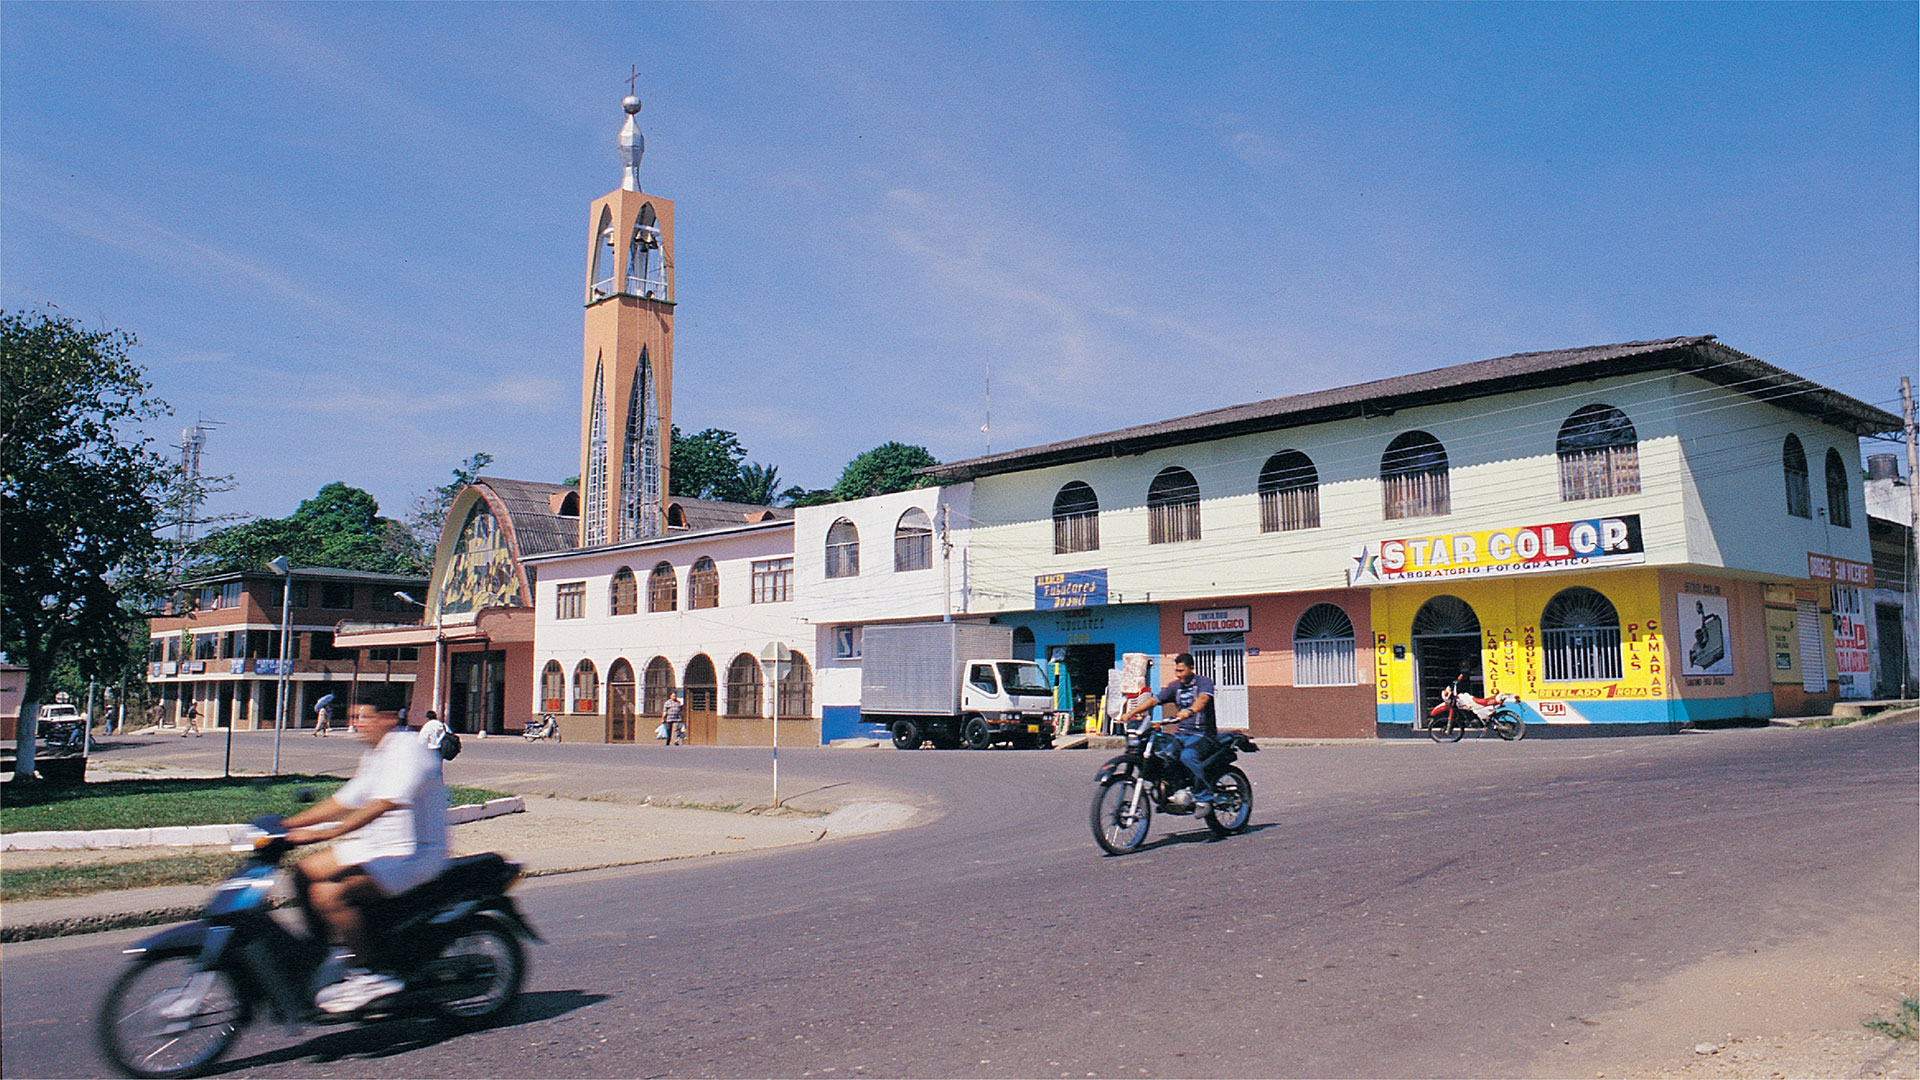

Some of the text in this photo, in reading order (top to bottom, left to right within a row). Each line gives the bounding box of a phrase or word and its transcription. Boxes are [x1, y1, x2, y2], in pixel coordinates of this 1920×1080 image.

[1382, 518, 1629, 570] STAR COLOR
[1037, 574, 1065, 586] ALMACEN
[1387, 556, 1589, 580] LABORATORIO FOTOGRAFICO
[1056, 618, 1104, 632] TUBULARES
[1187, 619, 1244, 631] ODONTOLOGICO
[1503, 627, 1515, 675] ALBUMES
[1628, 623, 1641, 670] PILAS
[1646, 620, 1662, 697] CAMARAS
[1377, 634, 1389, 699] ROLLOS
[1539, 683, 1647, 698] REVELADO 1 HORA
[1539, 702, 1563, 713] FUJI
